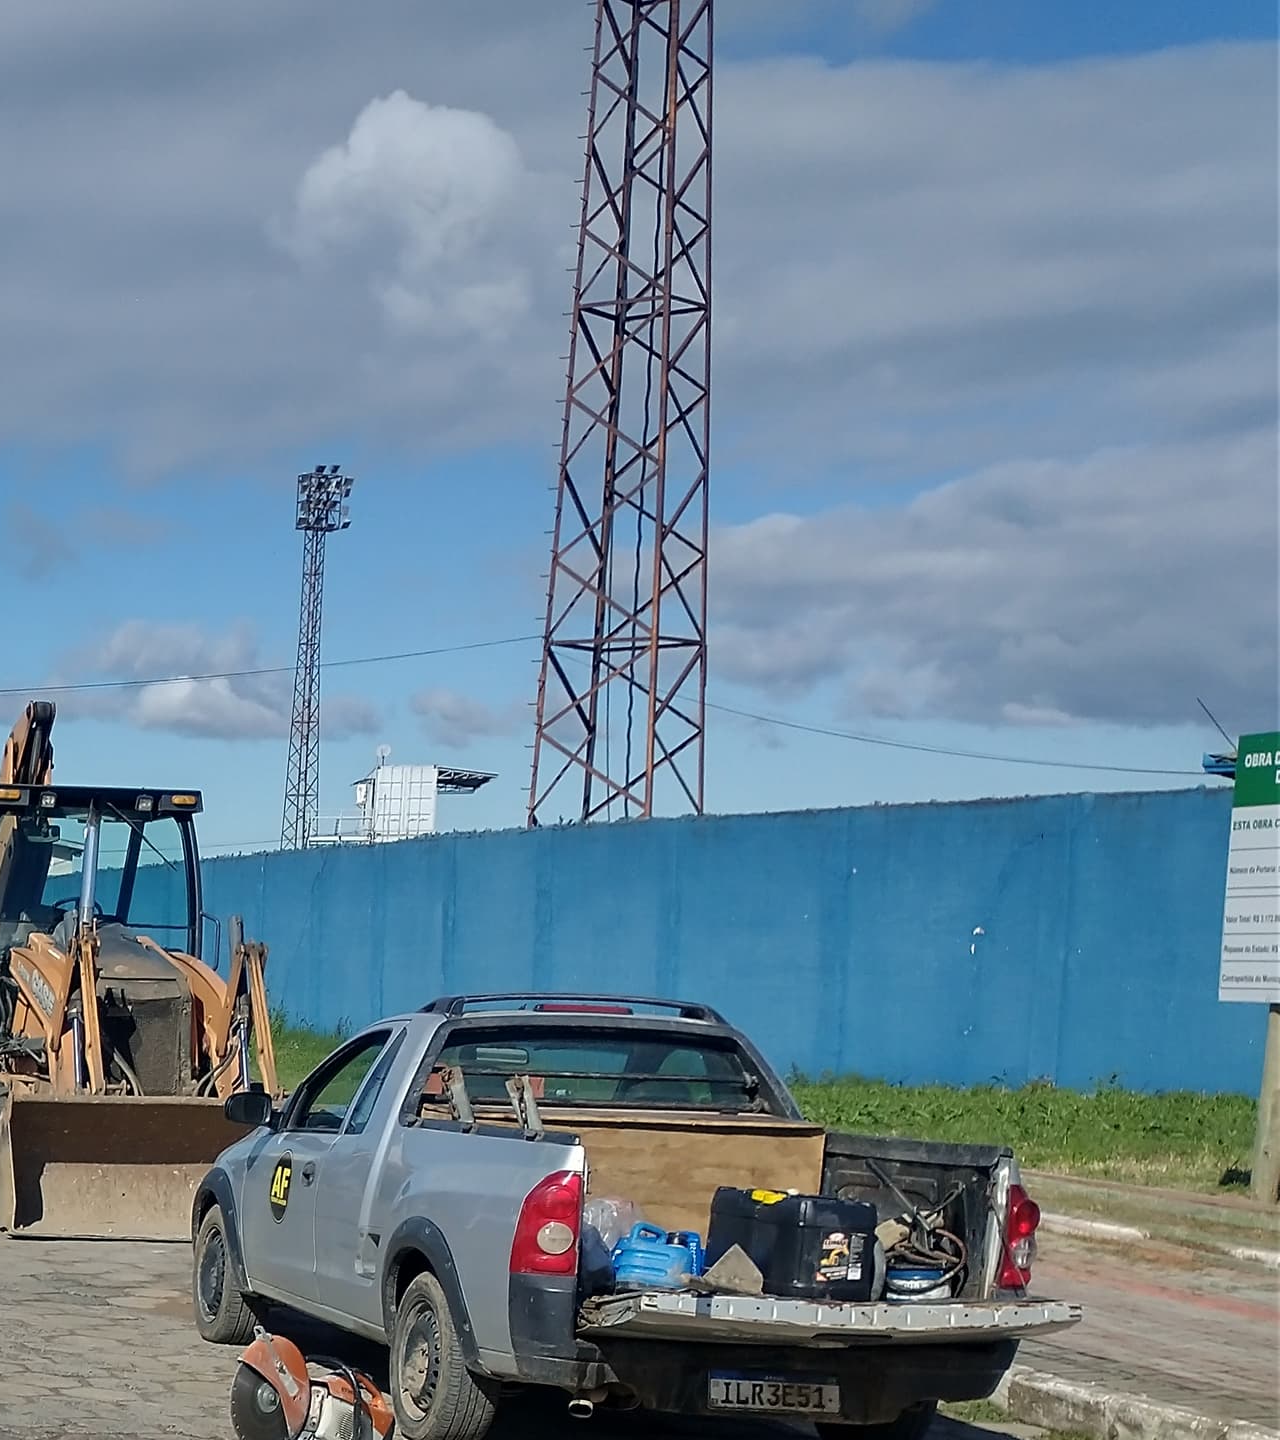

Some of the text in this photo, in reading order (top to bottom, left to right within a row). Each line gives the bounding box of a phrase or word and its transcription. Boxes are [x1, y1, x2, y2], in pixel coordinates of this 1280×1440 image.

[1244, 752, 1273, 768] OBRA
[271, 1165, 292, 1199] AF
[721, 1381, 826, 1409] ILR3E51
